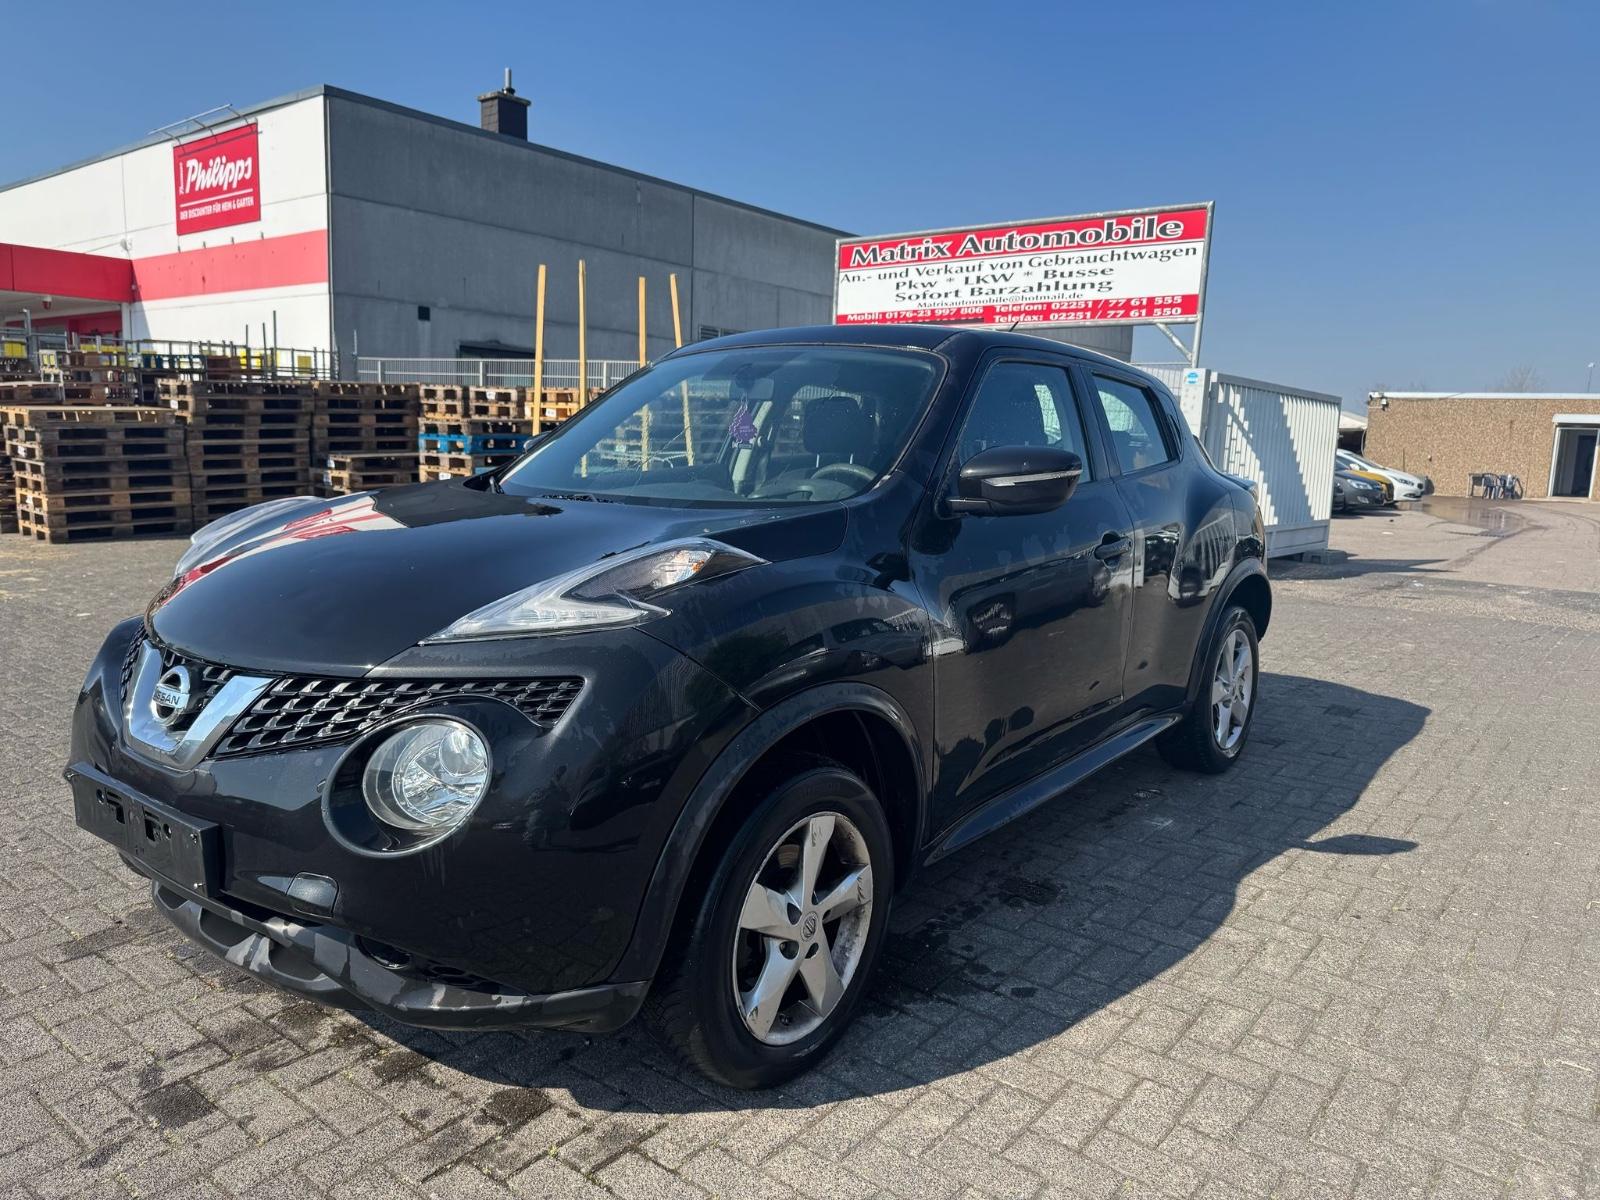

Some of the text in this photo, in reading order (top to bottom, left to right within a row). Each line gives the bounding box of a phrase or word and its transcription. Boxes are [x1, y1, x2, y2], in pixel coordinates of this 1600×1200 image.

[185, 155, 253, 194] Philipps
[850, 215, 1184, 267] Matrix Automobile
[878, 268, 909, 280] und
[915, 262, 984, 277] Verkauf
[989, 261, 1023, 271] von
[1028, 247, 1197, 268] Gebrauchtwagen
[895, 266, 1114, 291] Pkw LKW Busse
[895, 280, 1113, 303] Sofort Barzahlung
[847, 312, 882, 322] Mobil:
[885, 309, 932, 320] 0176-23
[935, 307, 957, 317] 997
[993, 312, 1043, 323] Telefax:
[1049, 310, 1091, 321] 02251
[1106, 309, 1125, 319] 77
[1128, 308, 1147, 318] 61
[1152, 307, 1182, 317] 550
[994, 302, 1047, 313] Telefon:
[1051, 300, 1093, 310] 02251
[1108, 298, 1127, 308] 77
[1130, 297, 1148, 307] 61
[1153, 295, 1182, 305] 555
